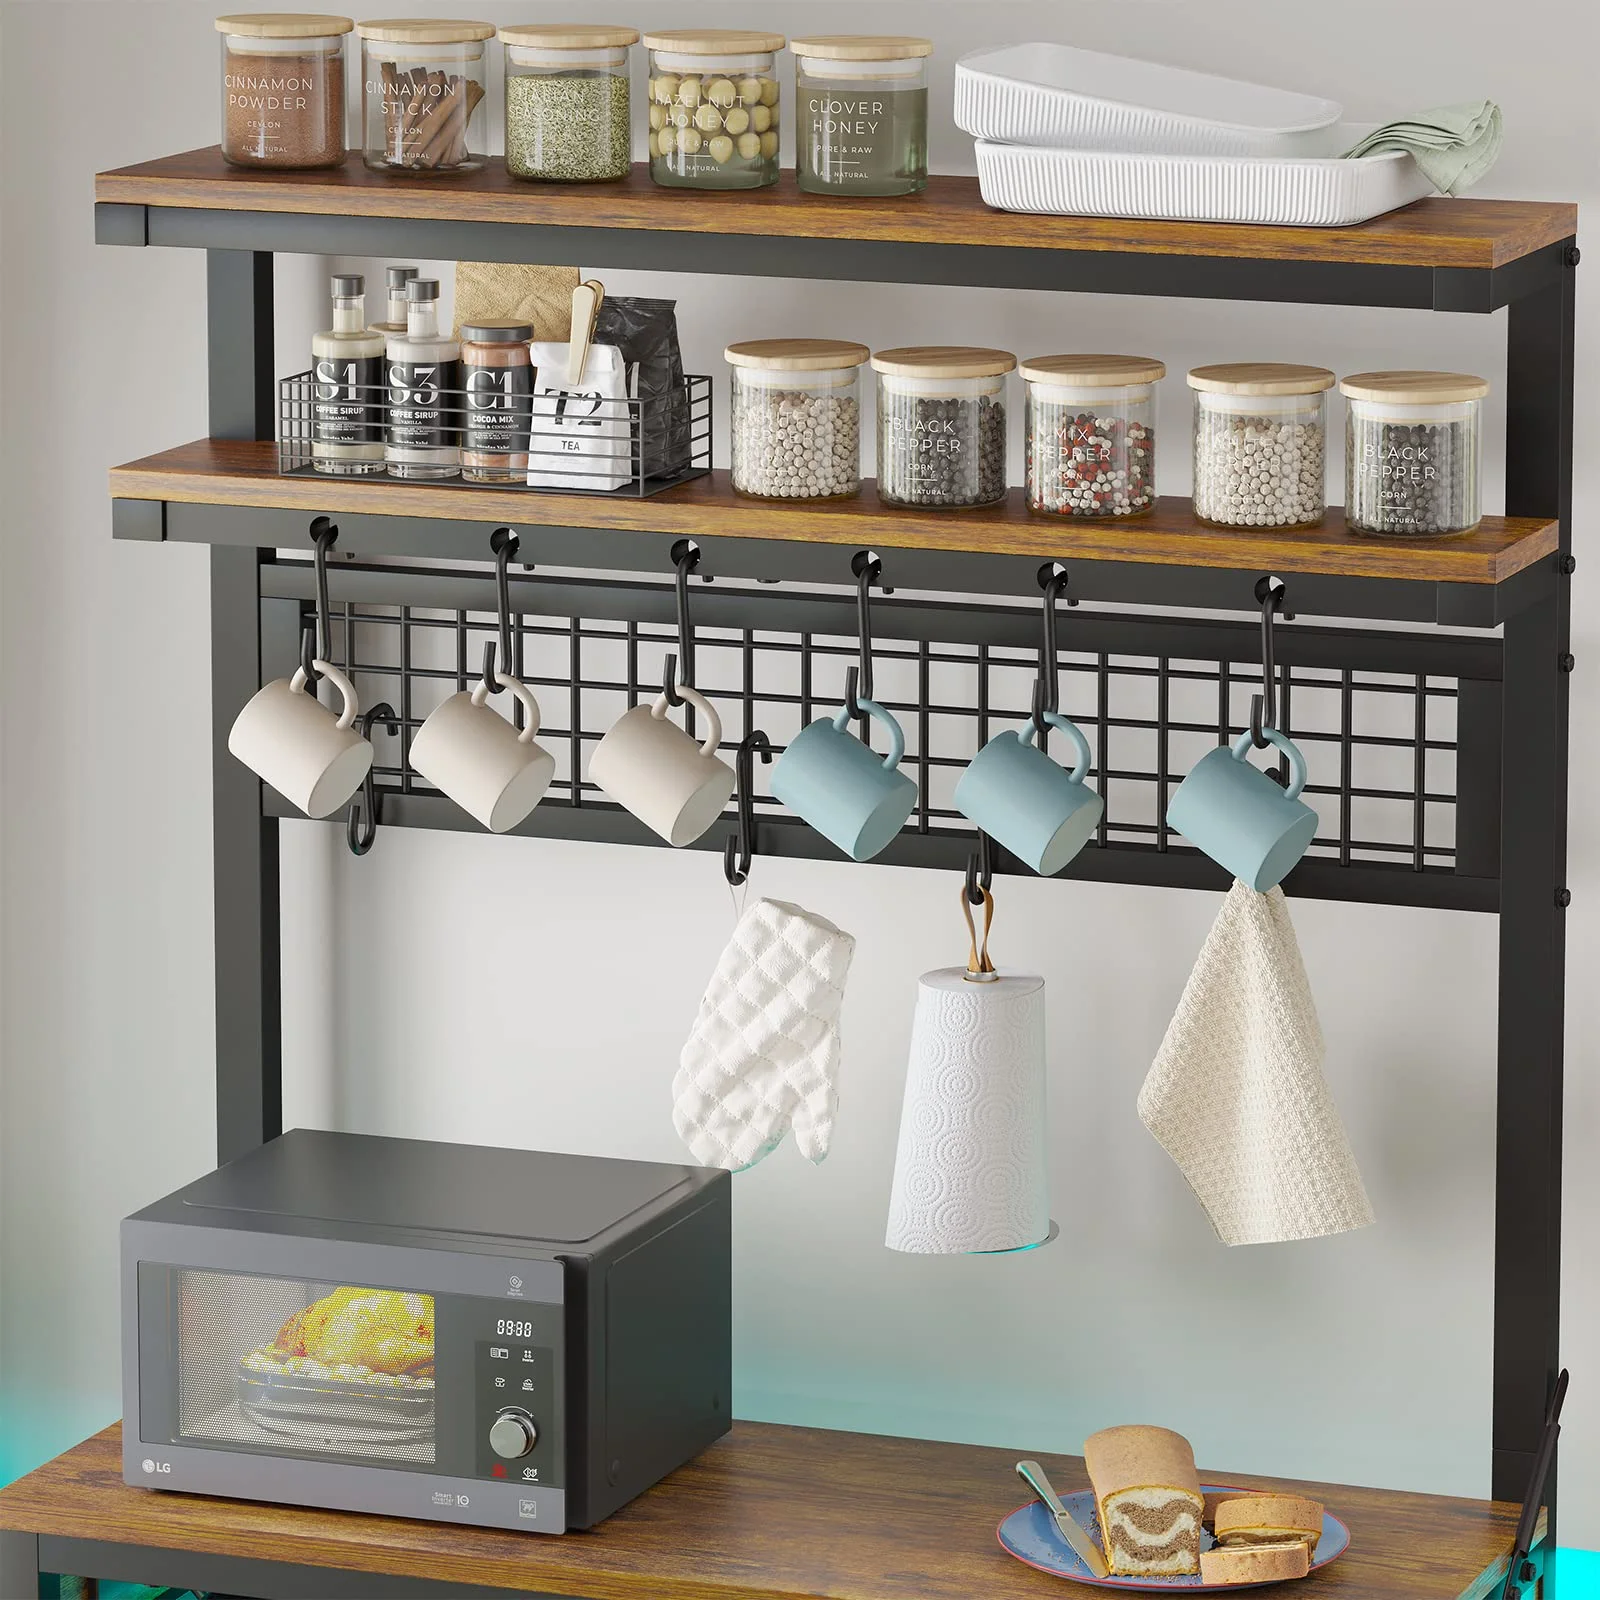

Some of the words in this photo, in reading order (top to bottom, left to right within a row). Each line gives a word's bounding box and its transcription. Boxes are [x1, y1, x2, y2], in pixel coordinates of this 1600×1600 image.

[224, 74, 313, 91] CINNAMON
[365, 80, 455, 97] CINNAMON
[229, 94, 306, 110] POWDER
[380, 101, 433, 116] STICK
[655, 94, 744, 109] HAZELNUT
[809, 99, 883, 115] CLOVER
[247, 120, 280, 128] CEYLON
[665, 113, 730, 128] HONEY
[813, 119, 879, 134] HONEY
[388, 126, 423, 135] CEYLON
[254, 145, 288, 153] NTURAL
[817, 144, 839, 153] PURE
[842, 146, 848, 154] &
[851, 146, 873, 154] RAW
[686, 164, 720, 172] NATURAL
[315, 361, 362, 401] S1
[388, 365, 439, 405] S3
[466, 370, 518, 410] C1
[316, 405, 338, 415] COFFEE
[340, 407, 364, 415] SIRUP
[390, 409, 413, 419] COFFEE
[414, 411, 439, 419] SIRUP
[544, 387, 602, 427] T2
[472, 415, 497, 423] COCOA
[893, 417, 954, 433] BLACK
[1055, 427, 1088, 441] MIX
[561, 440, 580, 451] TEA
[889, 436, 961, 452] PEPPER
[1038, 446, 1111, 461] PEPPER
[1365, 444, 1428, 460] BLACK
[908, 463, 933, 471] CORN
[1360, 463, 1435, 480] PEPPER
[1380, 490, 1407, 499] CORN
[1384, 517, 1421, 525] NATURAL
[156, 1462, 171, 1473] LG
